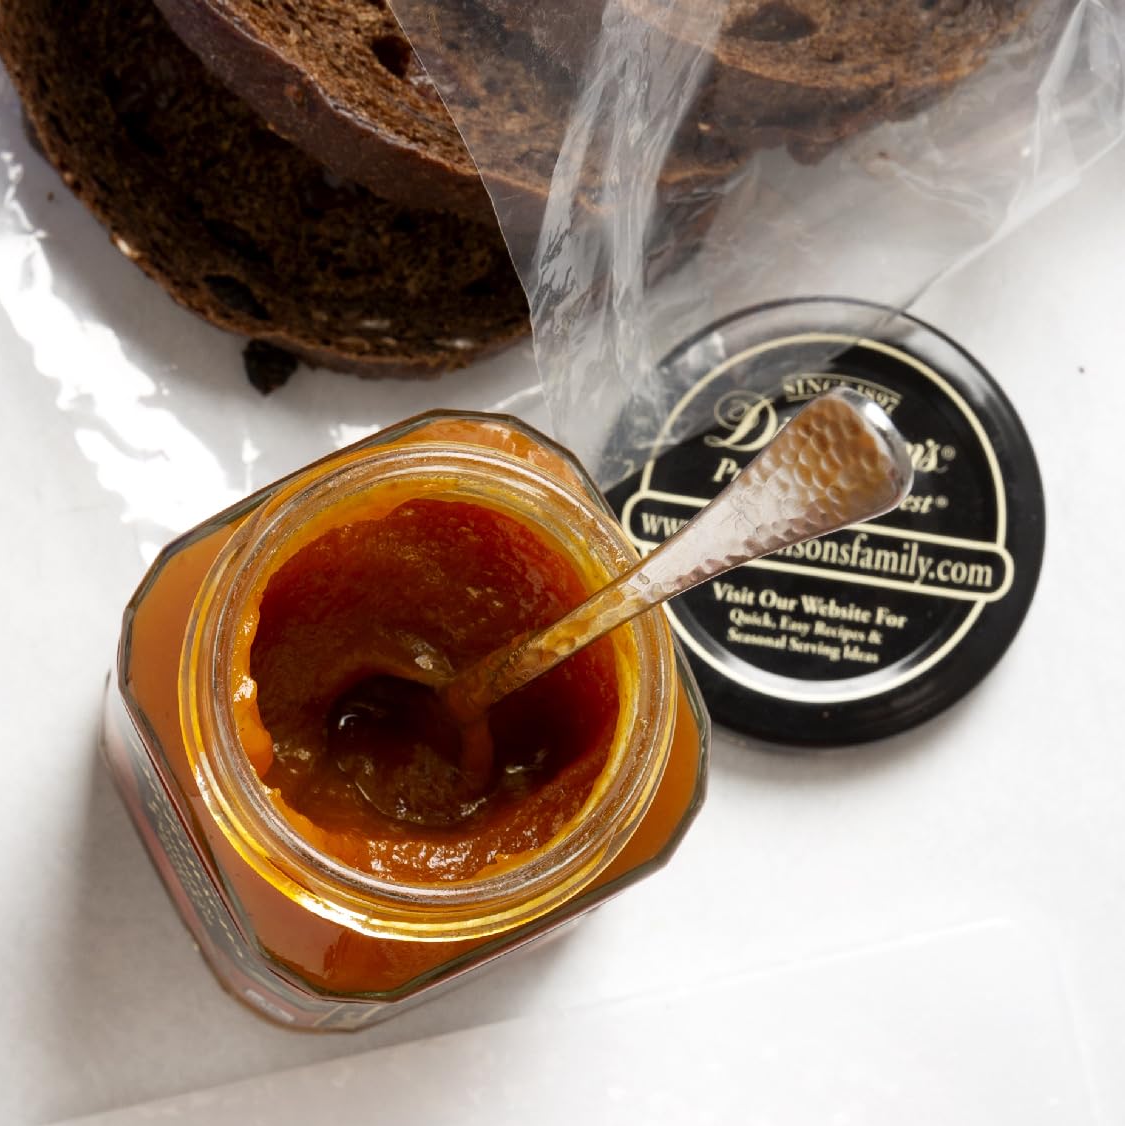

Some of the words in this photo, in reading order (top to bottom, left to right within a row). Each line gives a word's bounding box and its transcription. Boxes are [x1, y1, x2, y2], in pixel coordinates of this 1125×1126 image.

[713, 581, 756, 606] Visit
[758, 588, 799, 612] Our
[800, 594, 872, 624] Website
[874, 606, 908, 629] For
[726, 626, 788, 650] Seasonal
[788, 636, 842, 662] Serving
[843, 643, 880, 665] Ideas
[779, 615, 811, 637] Easy
[813, 620, 866, 643] Recipes
[867, 629, 883, 645] &
